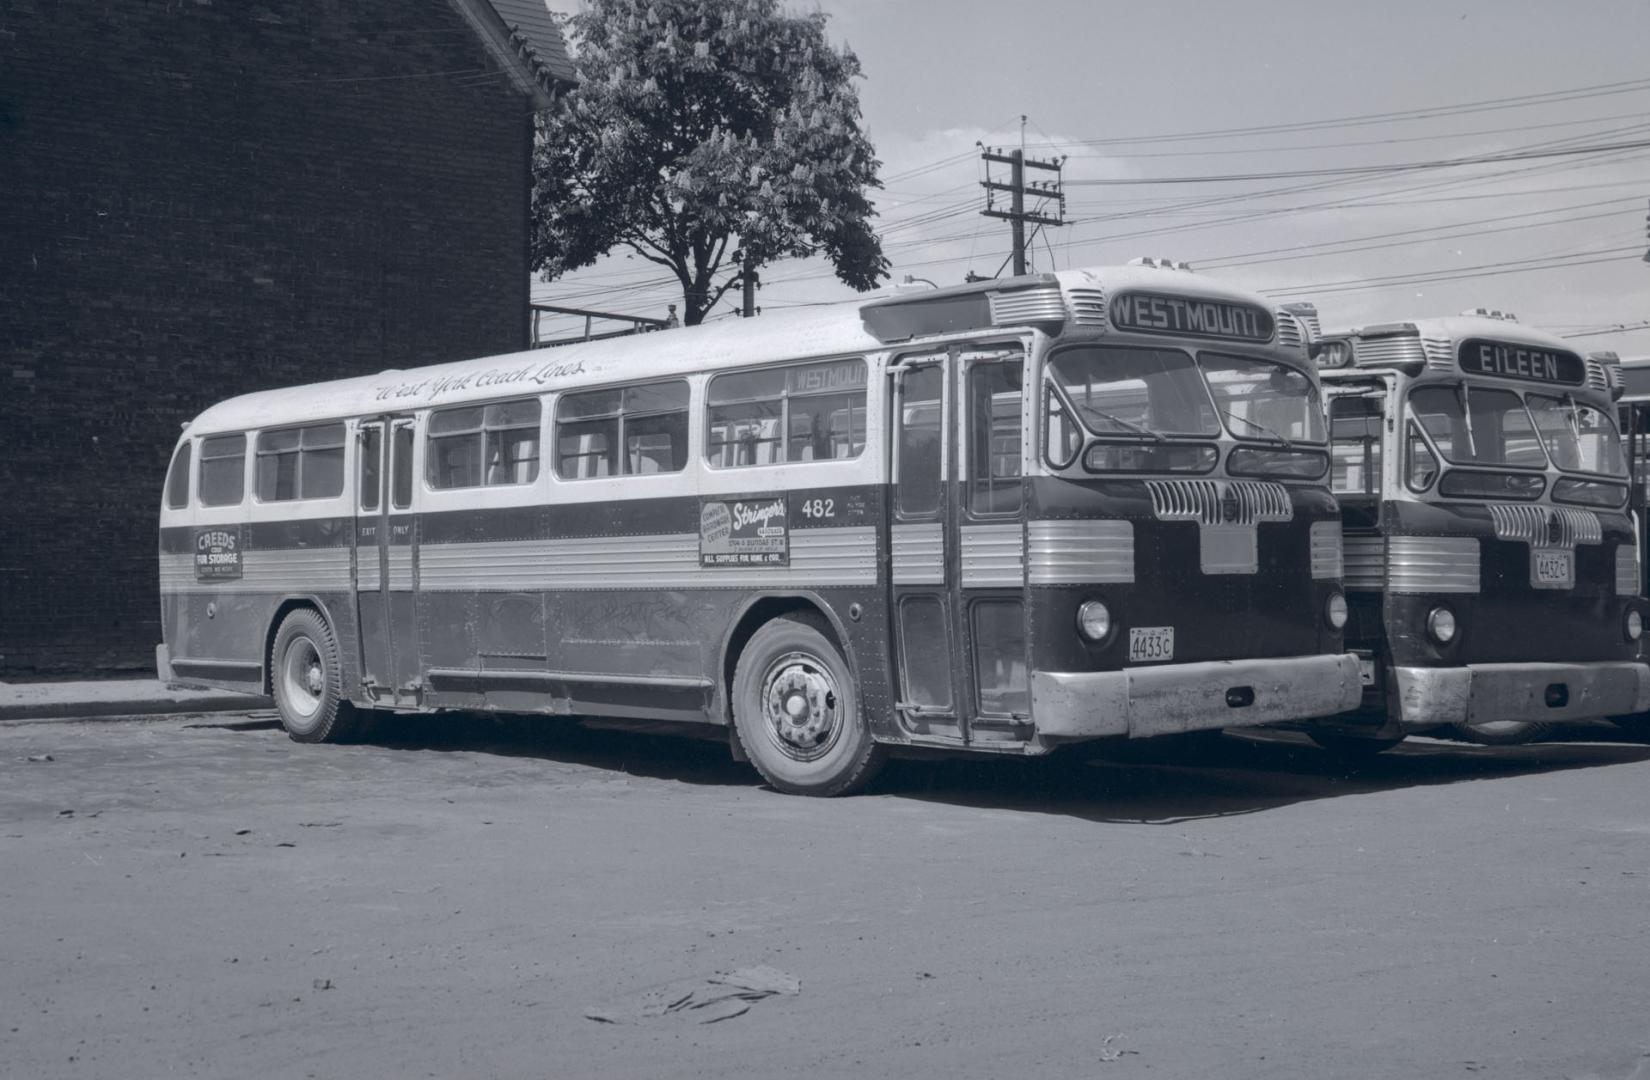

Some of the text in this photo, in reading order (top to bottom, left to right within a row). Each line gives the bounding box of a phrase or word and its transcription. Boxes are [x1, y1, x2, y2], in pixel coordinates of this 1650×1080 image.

[1112, 295, 1260, 337] WESTMOUNT
[530, 359, 585, 385] Lines
[1480, 345, 1558, 379] EILEEN
[802, 499, 835, 518] 482
[198, 531, 235, 550] CREEDS
